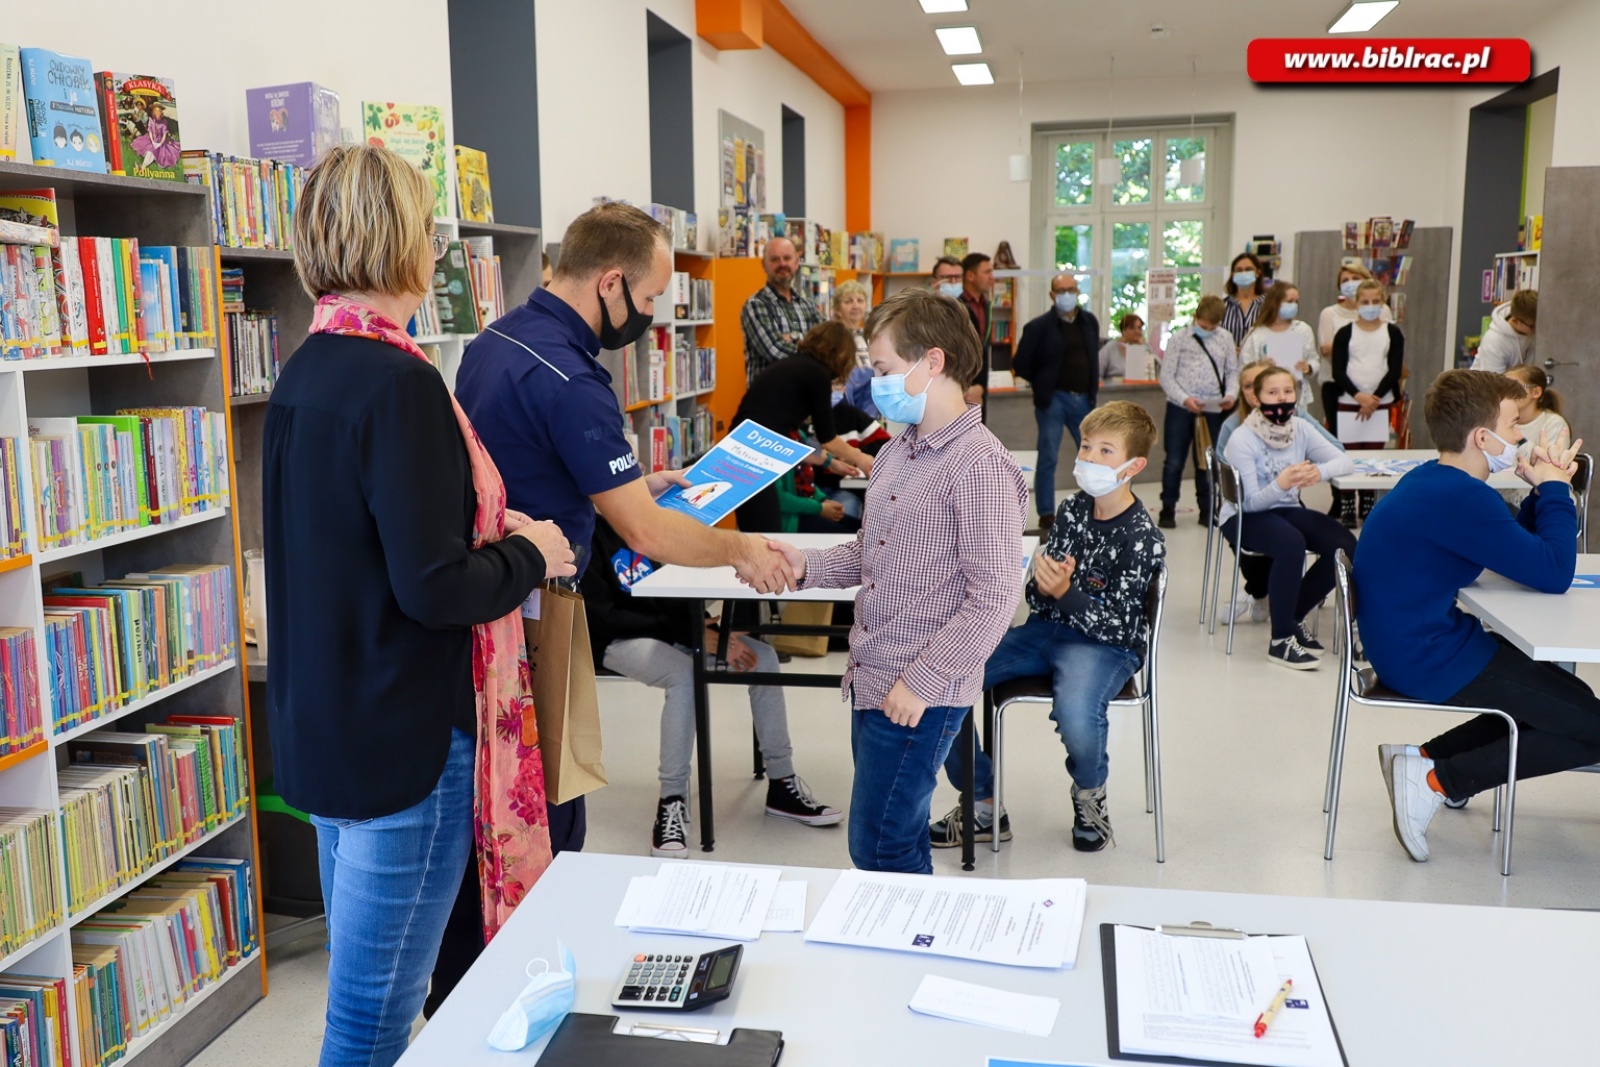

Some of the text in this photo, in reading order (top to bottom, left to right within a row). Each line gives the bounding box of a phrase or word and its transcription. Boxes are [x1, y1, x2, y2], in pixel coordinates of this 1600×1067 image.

[128, 81, 162, 92] KLASYKA
[133, 167, 176, 179] Pollyanna
[746, 429, 796, 458] Dyplom
[608, 454, 638, 476] POLIC
